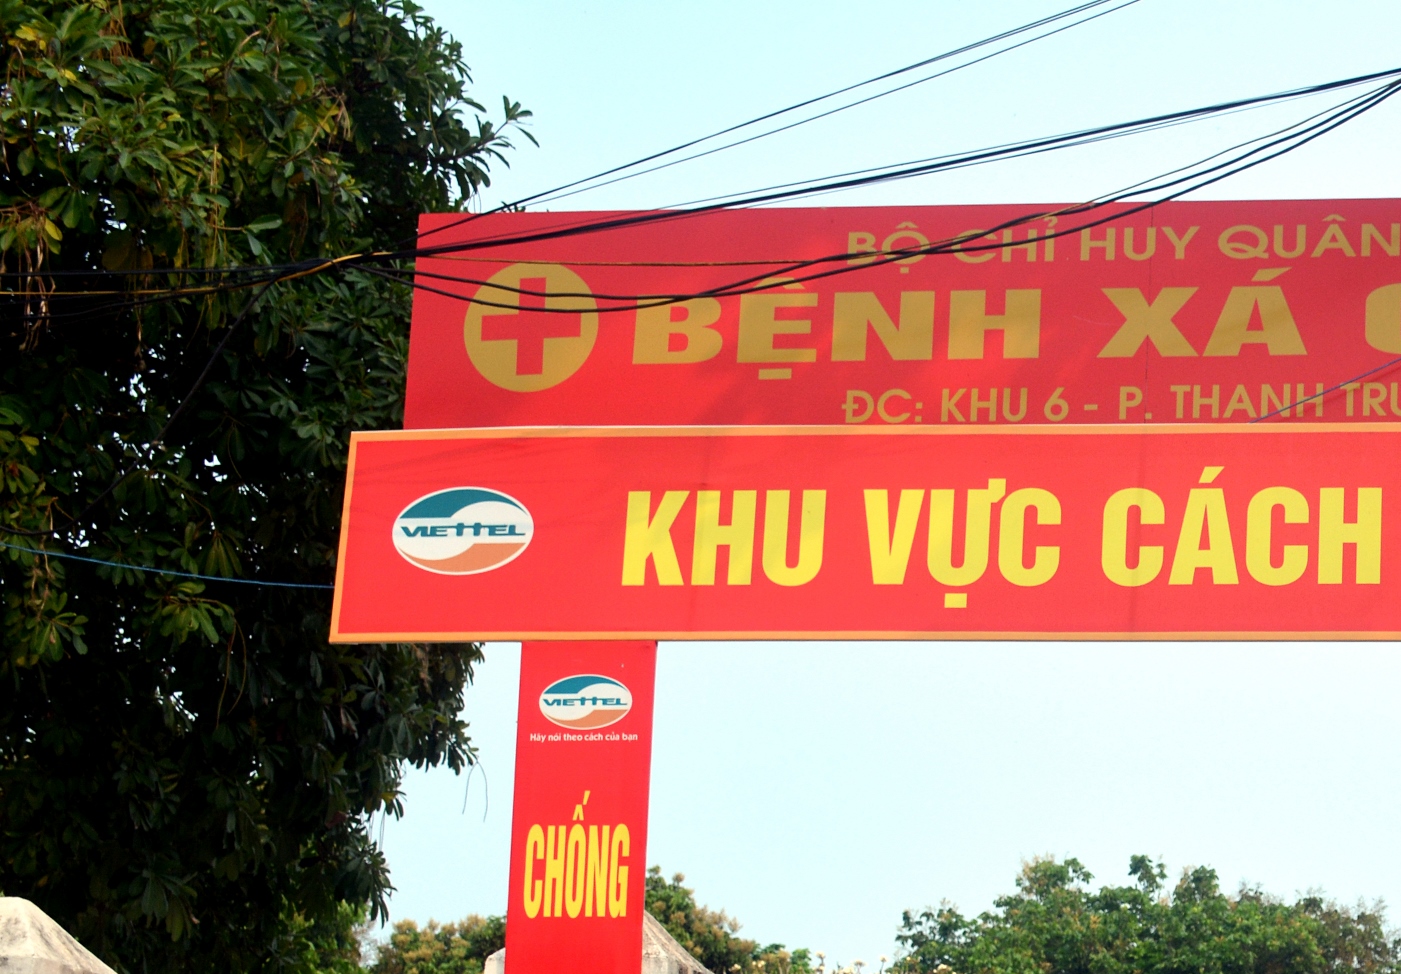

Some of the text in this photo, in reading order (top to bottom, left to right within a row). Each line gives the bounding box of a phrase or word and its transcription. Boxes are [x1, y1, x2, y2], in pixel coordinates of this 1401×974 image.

[846, 221, 931, 274] BỘ
[951, 215, 1058, 264] CHỈ
[1079, 227, 1200, 261] HUY
[1217, 214, 1401, 260] QUÂN
[631, 277, 1043, 380] BỆNH
[1096, 267, 1308, 359] XÁ
[841, 388, 924, 424] ĐC:
[940, 387, 1029, 424] KHU
[1043, 387, 1070, 422] 6
[1118, 386, 1153, 420] P.
[1170, 383, 1325, 419] THANH
[400, 522, 527, 538] VIETTEL
[620, 489, 828, 587] KHU
[863, 478, 1062, 609] VỰC
[1101, 466, 1384, 587] CÁCH
[542, 696, 628, 707] VIETTEL
[548, 732, 562, 742] nói
[563, 732, 584, 742] theo
[584, 732, 604, 742] cách
[605, 731, 620, 741] của
[622, 732, 638, 743] bạn
[523, 790, 631, 919] CHỐNG
